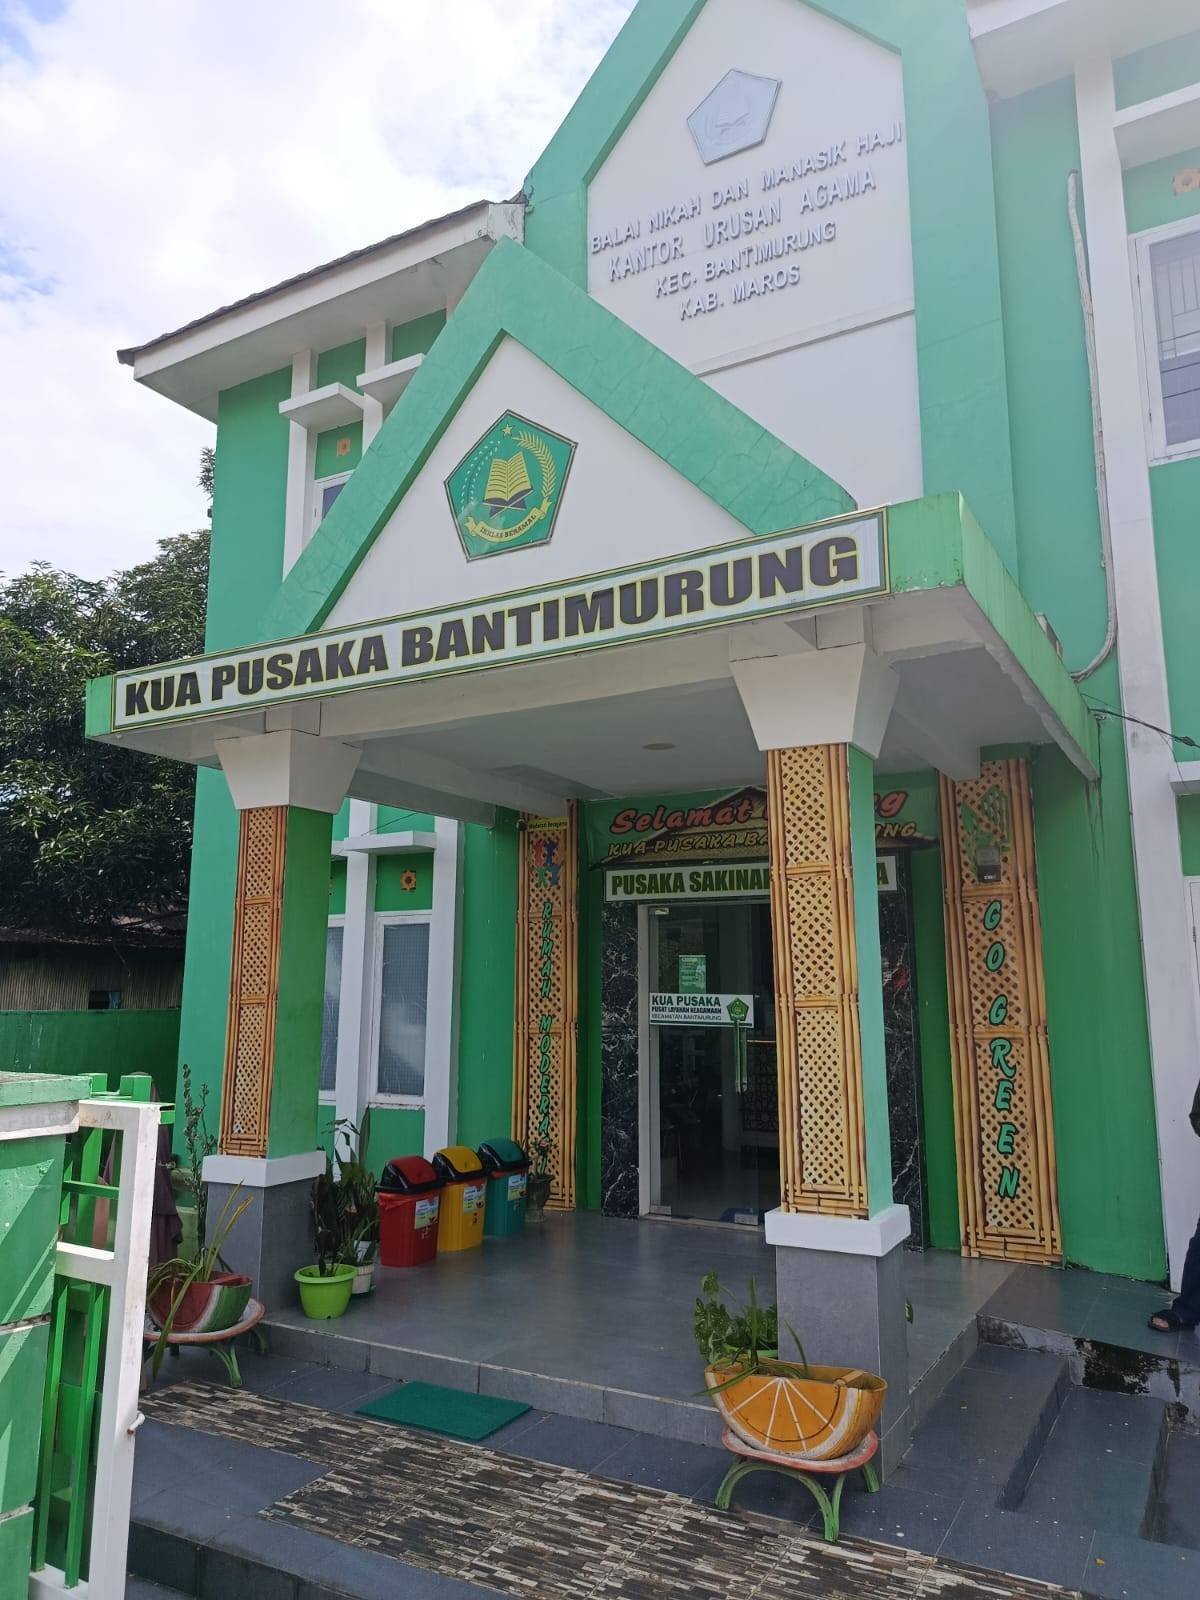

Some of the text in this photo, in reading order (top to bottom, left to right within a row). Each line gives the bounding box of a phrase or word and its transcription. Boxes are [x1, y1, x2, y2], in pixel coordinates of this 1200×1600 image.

[591, 121, 903, 254] BALAI NIKAH DAN MANASIK HAJI
[608, 167, 877, 283] KANTOR URUSAN AGAMA
[655, 221, 837, 299] KEC. BANTIMURUNG
[679, 263, 801, 321] KAB. MAROS
[124, 536, 859, 717] KUA PUSAKA BANTIMURUNG
[608, 841, 647, 858] KUA
[653, 833, 737, 852] PUSAKA
[609, 798, 754, 835] Selamat
[612, 871, 685, 896] PUSAKA
[540, 901, 554, 999] RUMAH
[651, 995, 721, 1007] KUA PUSAKA
[538, 1014, 552, 1176] MODERAI
[988, 994, 1020, 1200] GREEN
